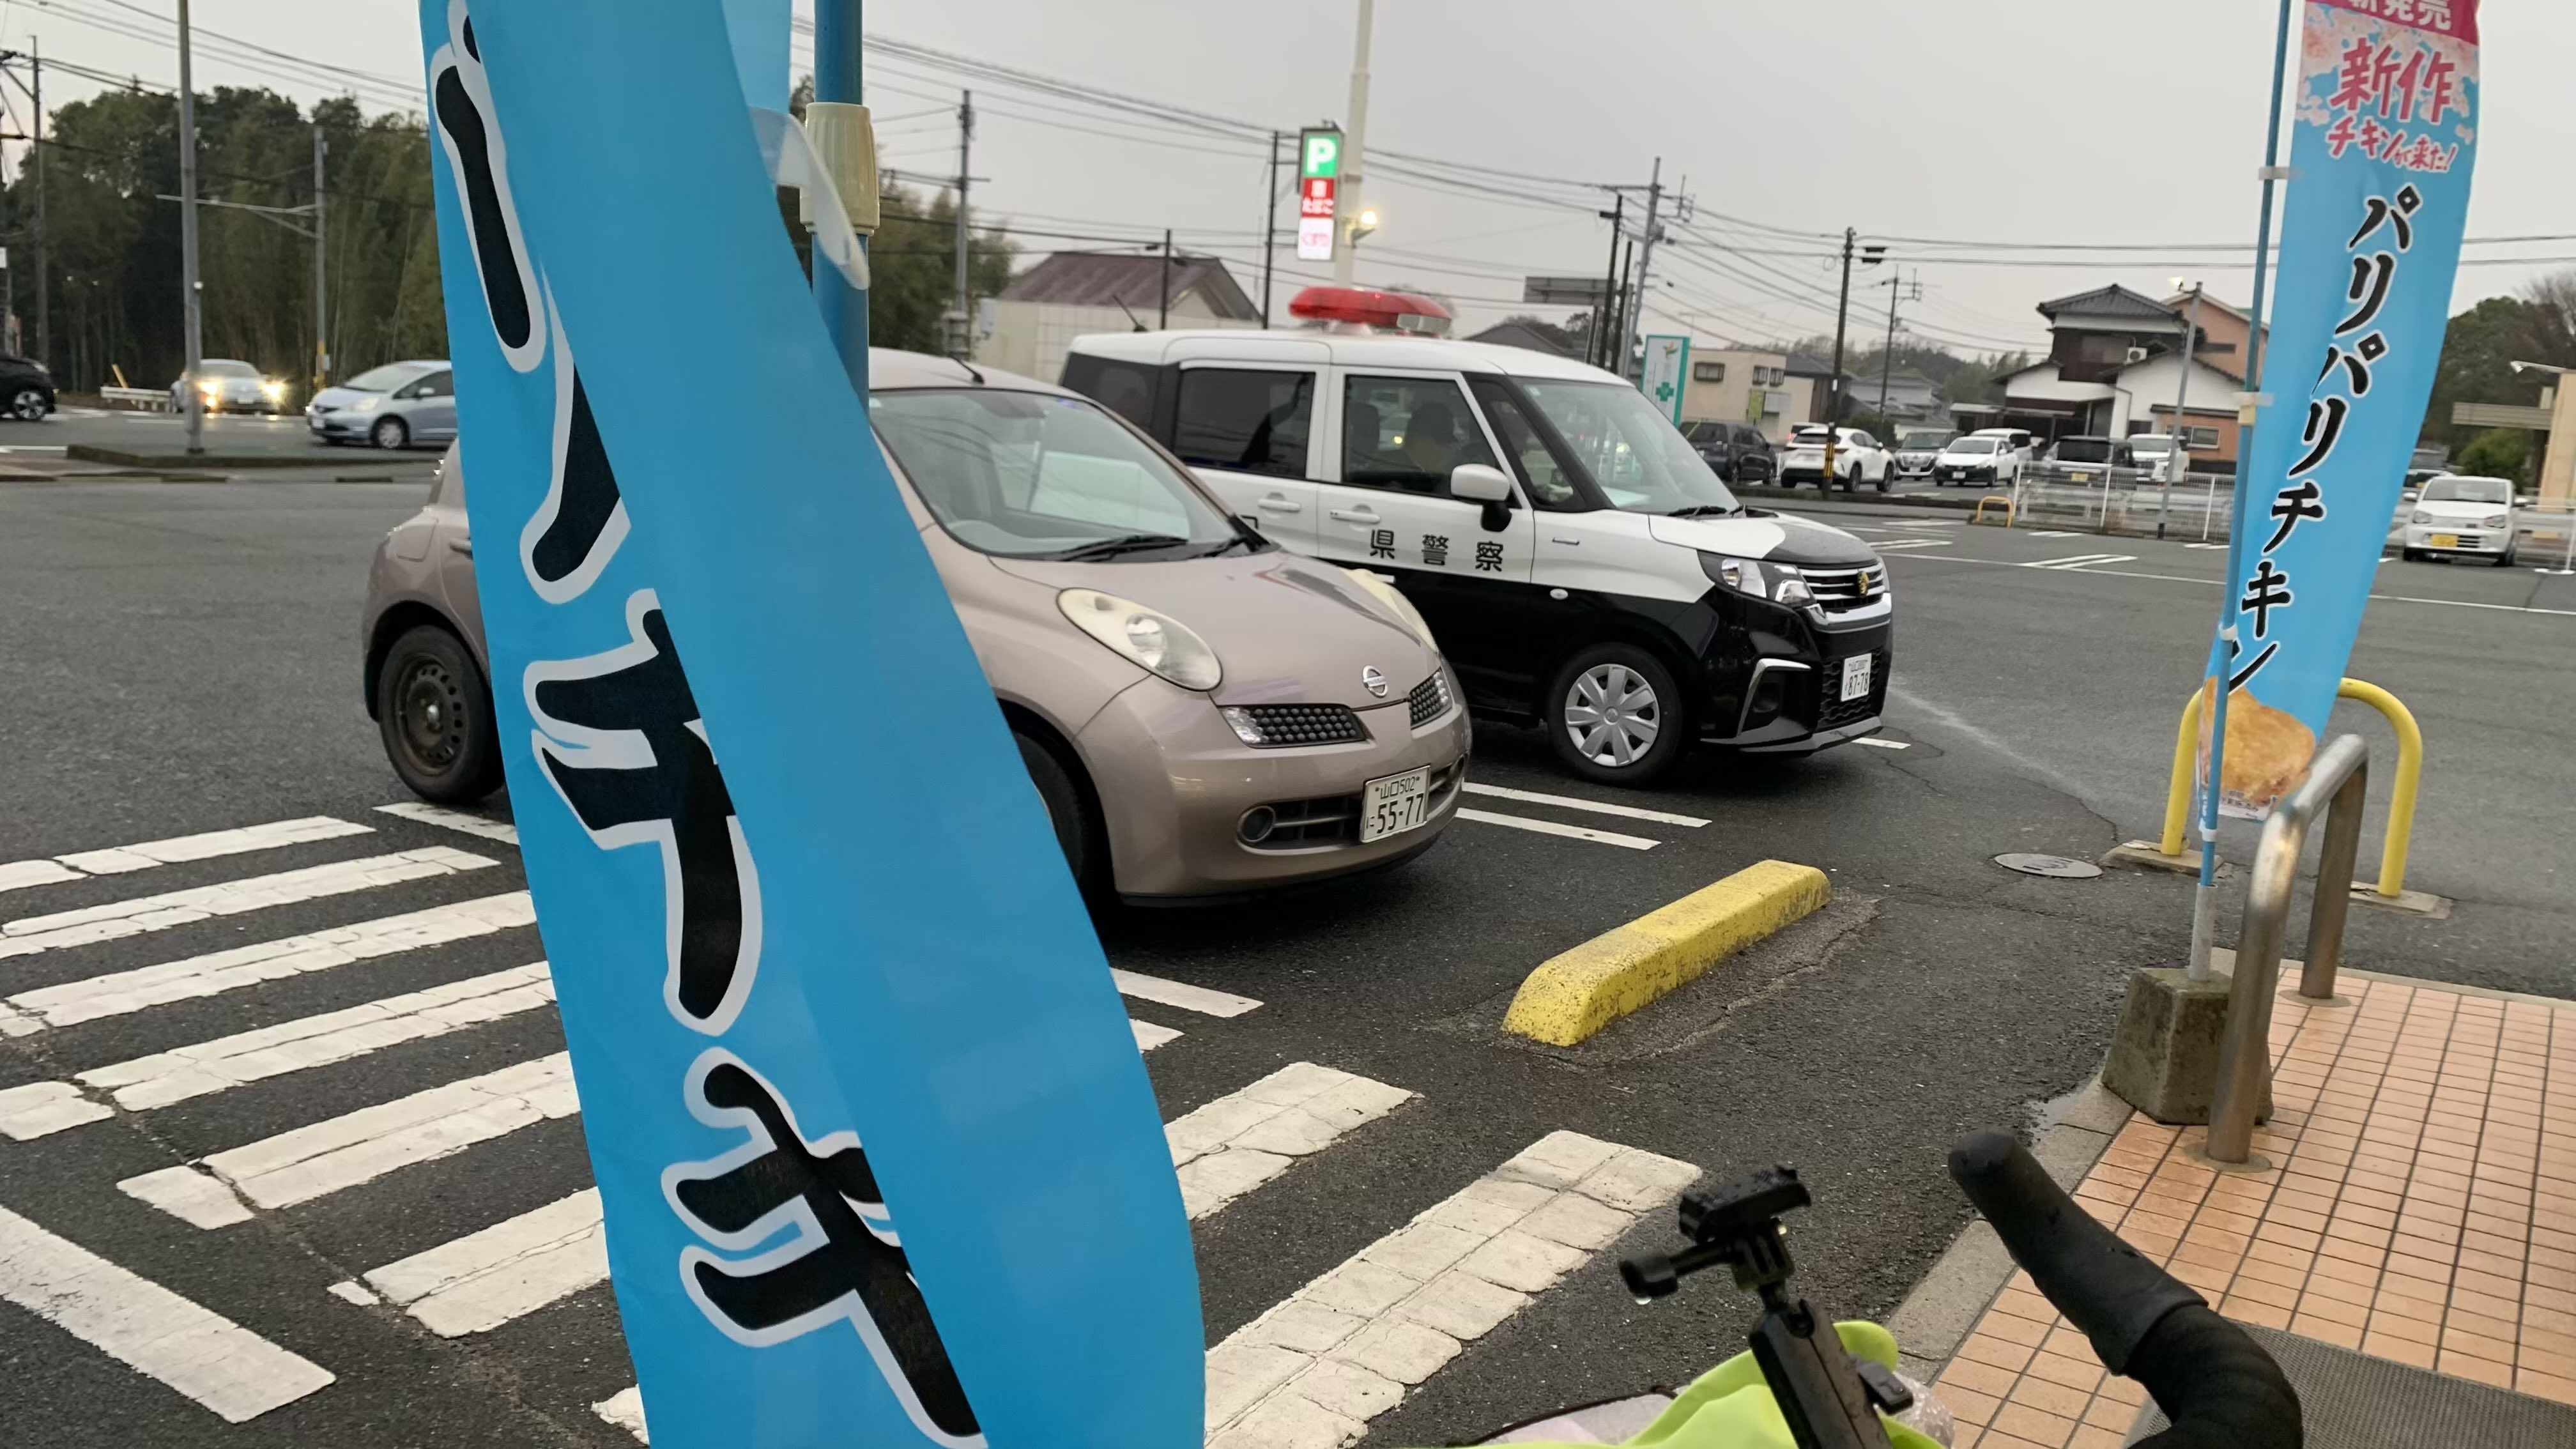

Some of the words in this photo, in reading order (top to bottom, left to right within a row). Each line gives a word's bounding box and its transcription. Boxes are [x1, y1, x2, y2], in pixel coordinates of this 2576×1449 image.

[2328, 37, 2455, 123] 新作
[1307, 137, 1336, 173] P
[2228, 185, 2421, 692] パリパリチキン
[1379, 776, 1416, 800] 山口502
[1376, 793, 1424, 834] 55-77
